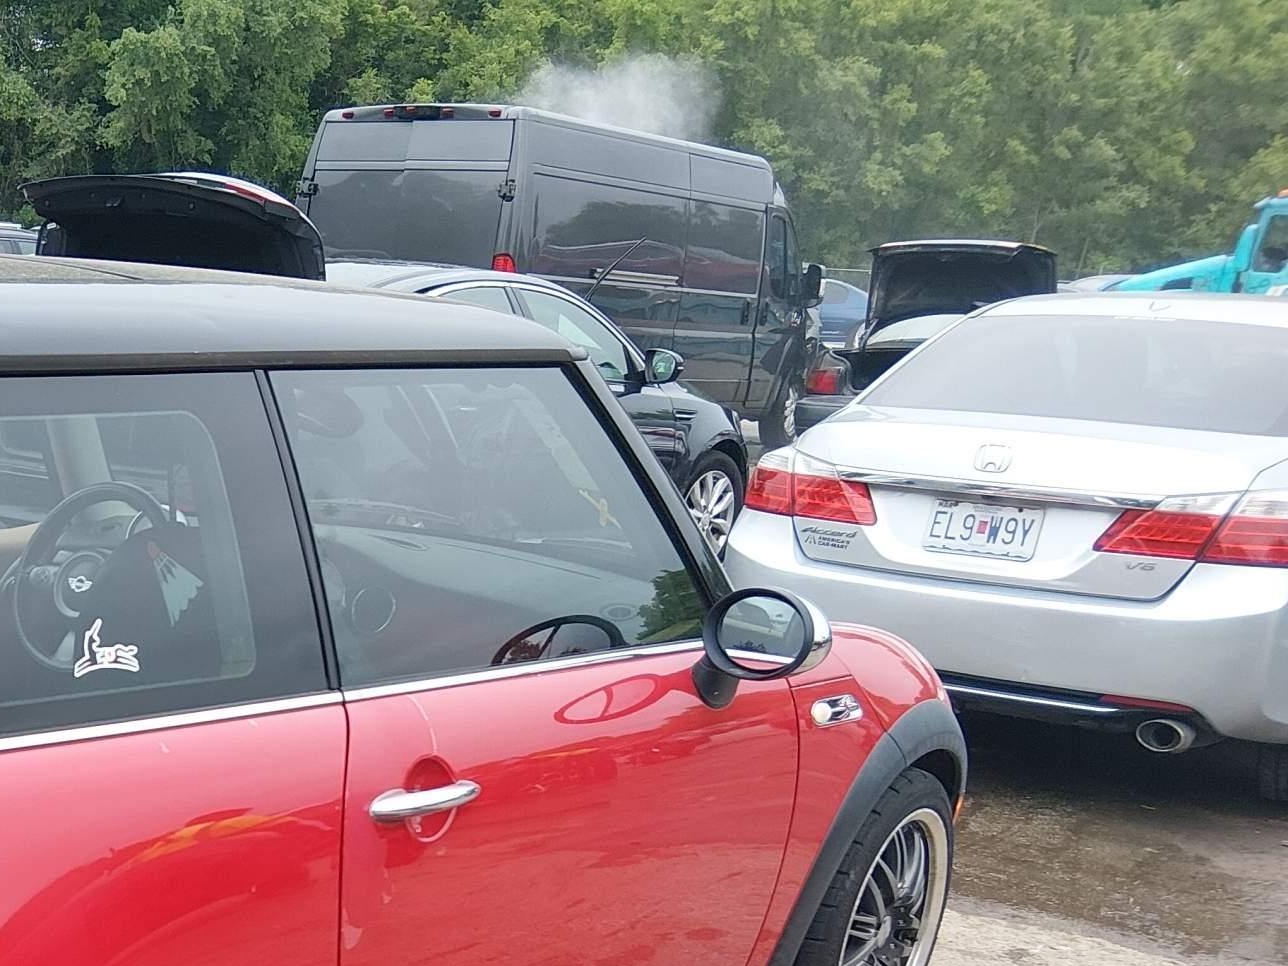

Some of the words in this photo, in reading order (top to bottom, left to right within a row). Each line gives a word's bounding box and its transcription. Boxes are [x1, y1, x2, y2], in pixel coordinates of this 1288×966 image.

[800, 526, 858, 539] Accord
[929, 510, 976, 541] EL9
[986, 515, 1035, 547] W9Y
[1126, 561, 1158, 571] V6
